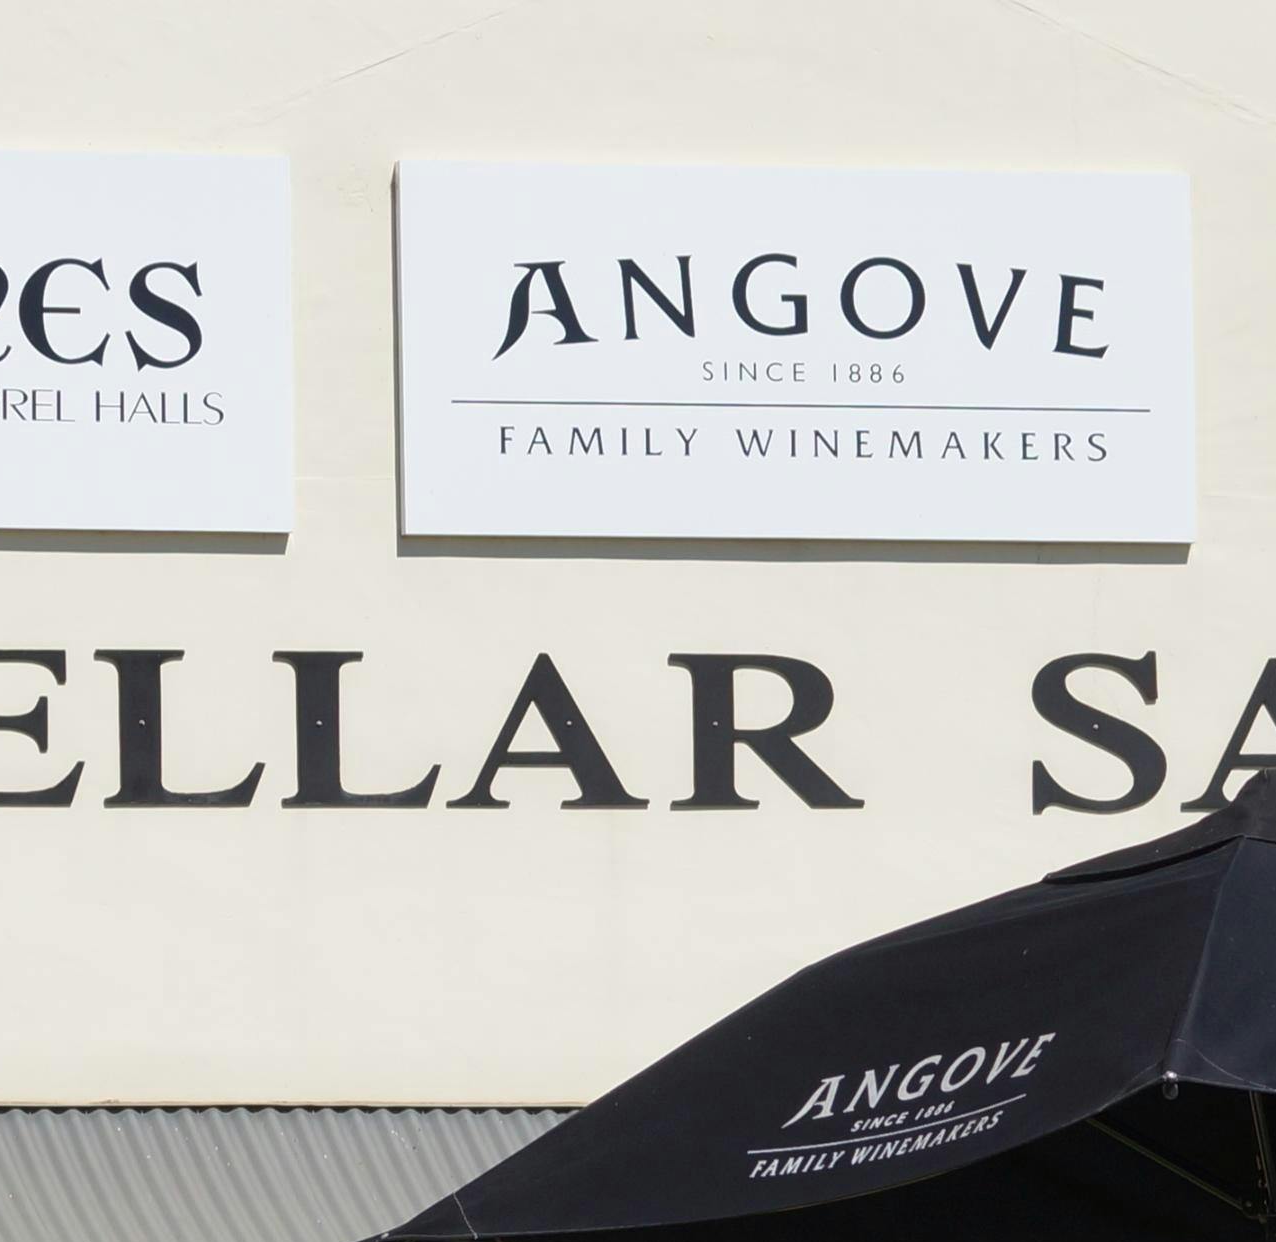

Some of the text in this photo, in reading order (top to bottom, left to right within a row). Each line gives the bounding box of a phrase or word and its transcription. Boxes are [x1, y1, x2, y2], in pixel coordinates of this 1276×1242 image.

[493, 253, 1109, 360] ANGOVE
[702, 360, 905, 384] SINCE 1886
[94, 391, 226, 426] HALLS
[500, 425, 1109, 463] FAMILY WINEMAKERS
[781, 1032, 1056, 1129] ANGOVE
[851, 1100, 956, 1132] SINCE 1886
[749, 1110, 1004, 1178] FAMILY WINEMAKERS
